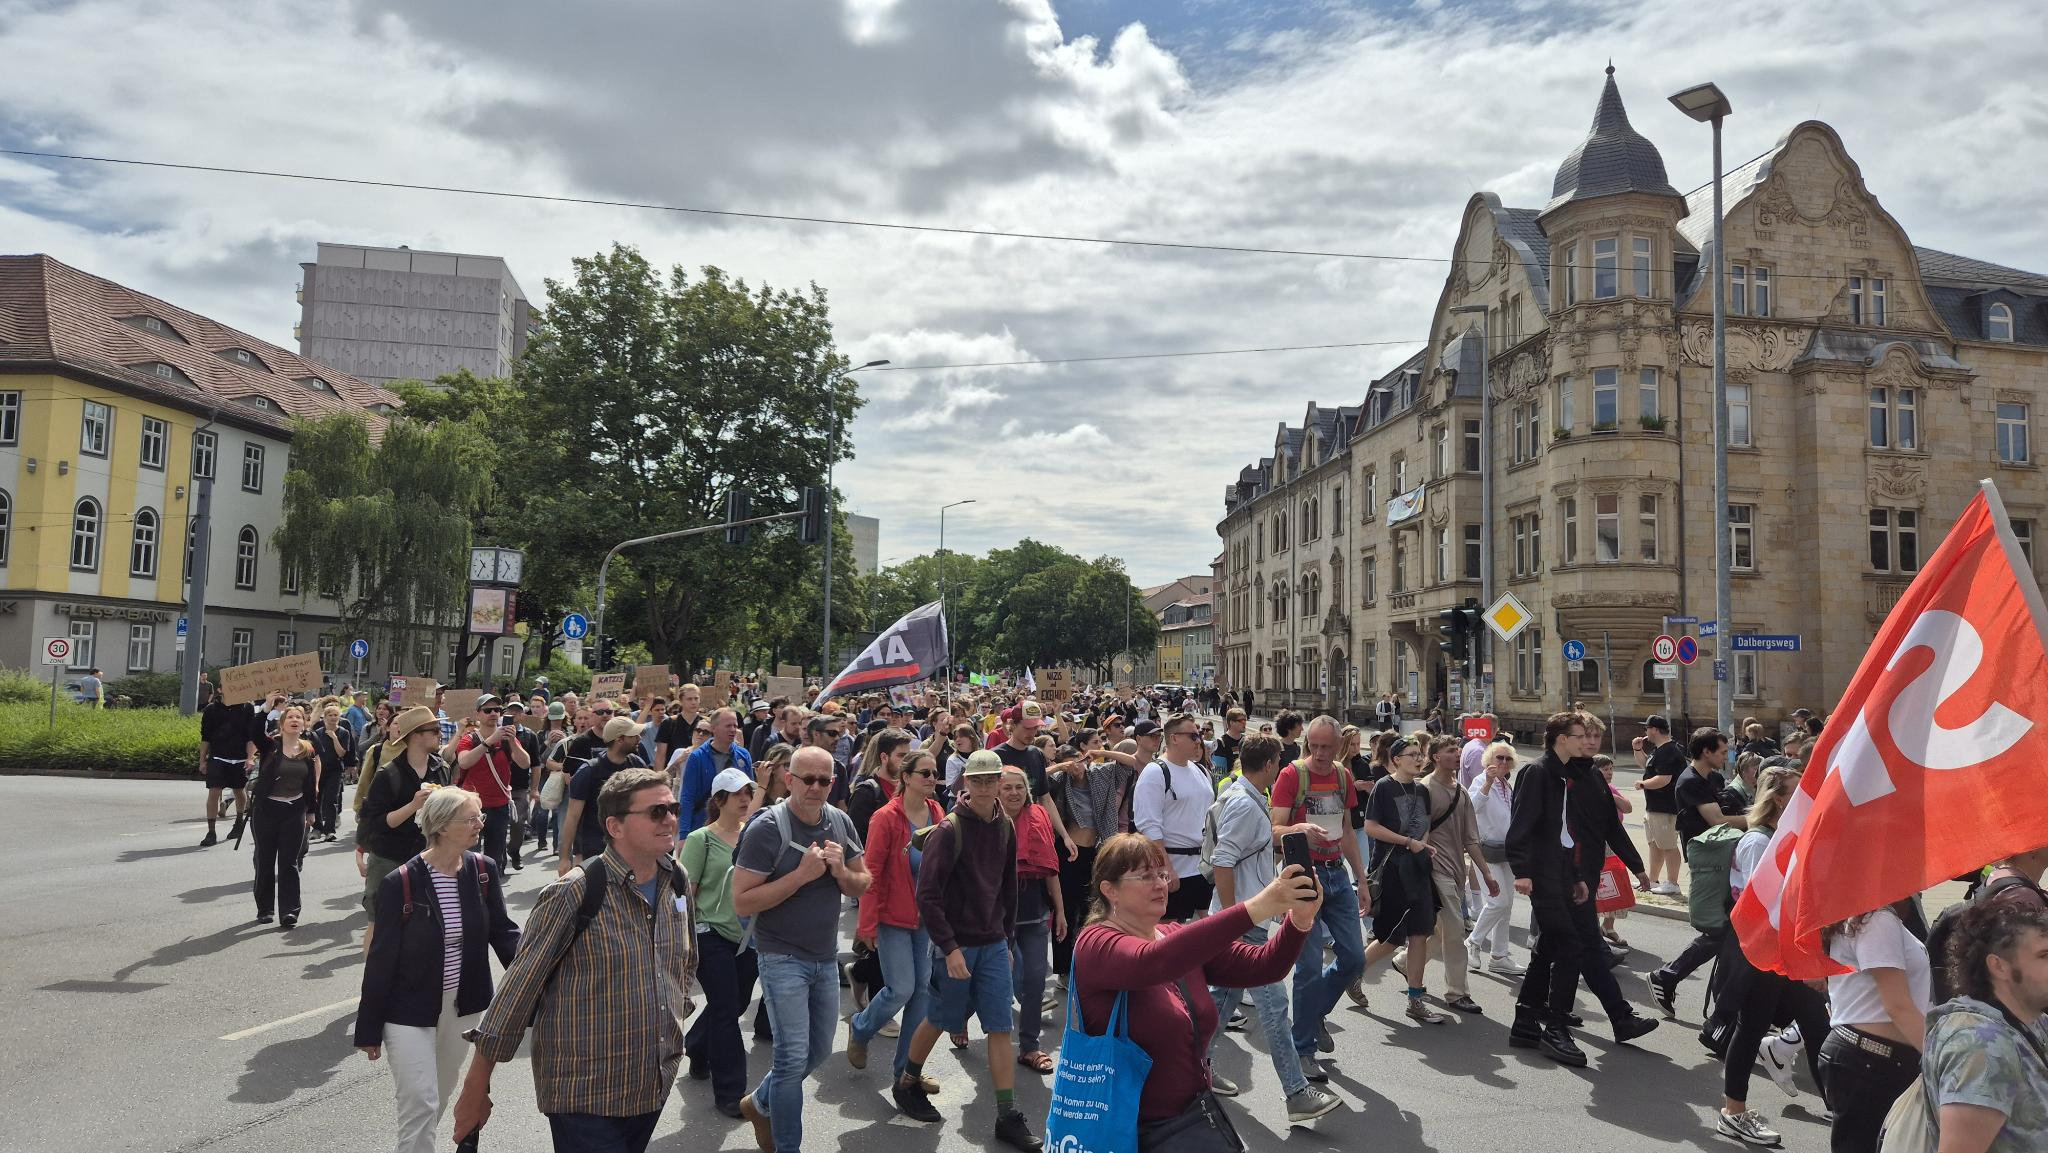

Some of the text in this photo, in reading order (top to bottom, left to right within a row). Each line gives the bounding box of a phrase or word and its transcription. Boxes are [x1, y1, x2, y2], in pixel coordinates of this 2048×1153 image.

[52, 644, 65, 653] 30
[1738, 636, 1795, 650] Dalbergsweg
[1046, 671, 1063, 680] NAZIS
[595, 690, 619, 699] NAZIS
[1467, 728, 1487, 737] SPD
[1070, 1060, 1085, 1071] Lust
[1087, 1073, 1106, 1084] sein?
[1064, 1095, 1085, 1107] komm
[1095, 1101, 1109, 1111] uns
[1063, 1110, 1083, 1120] werde
[1083, 1112, 1099, 1121] zum
